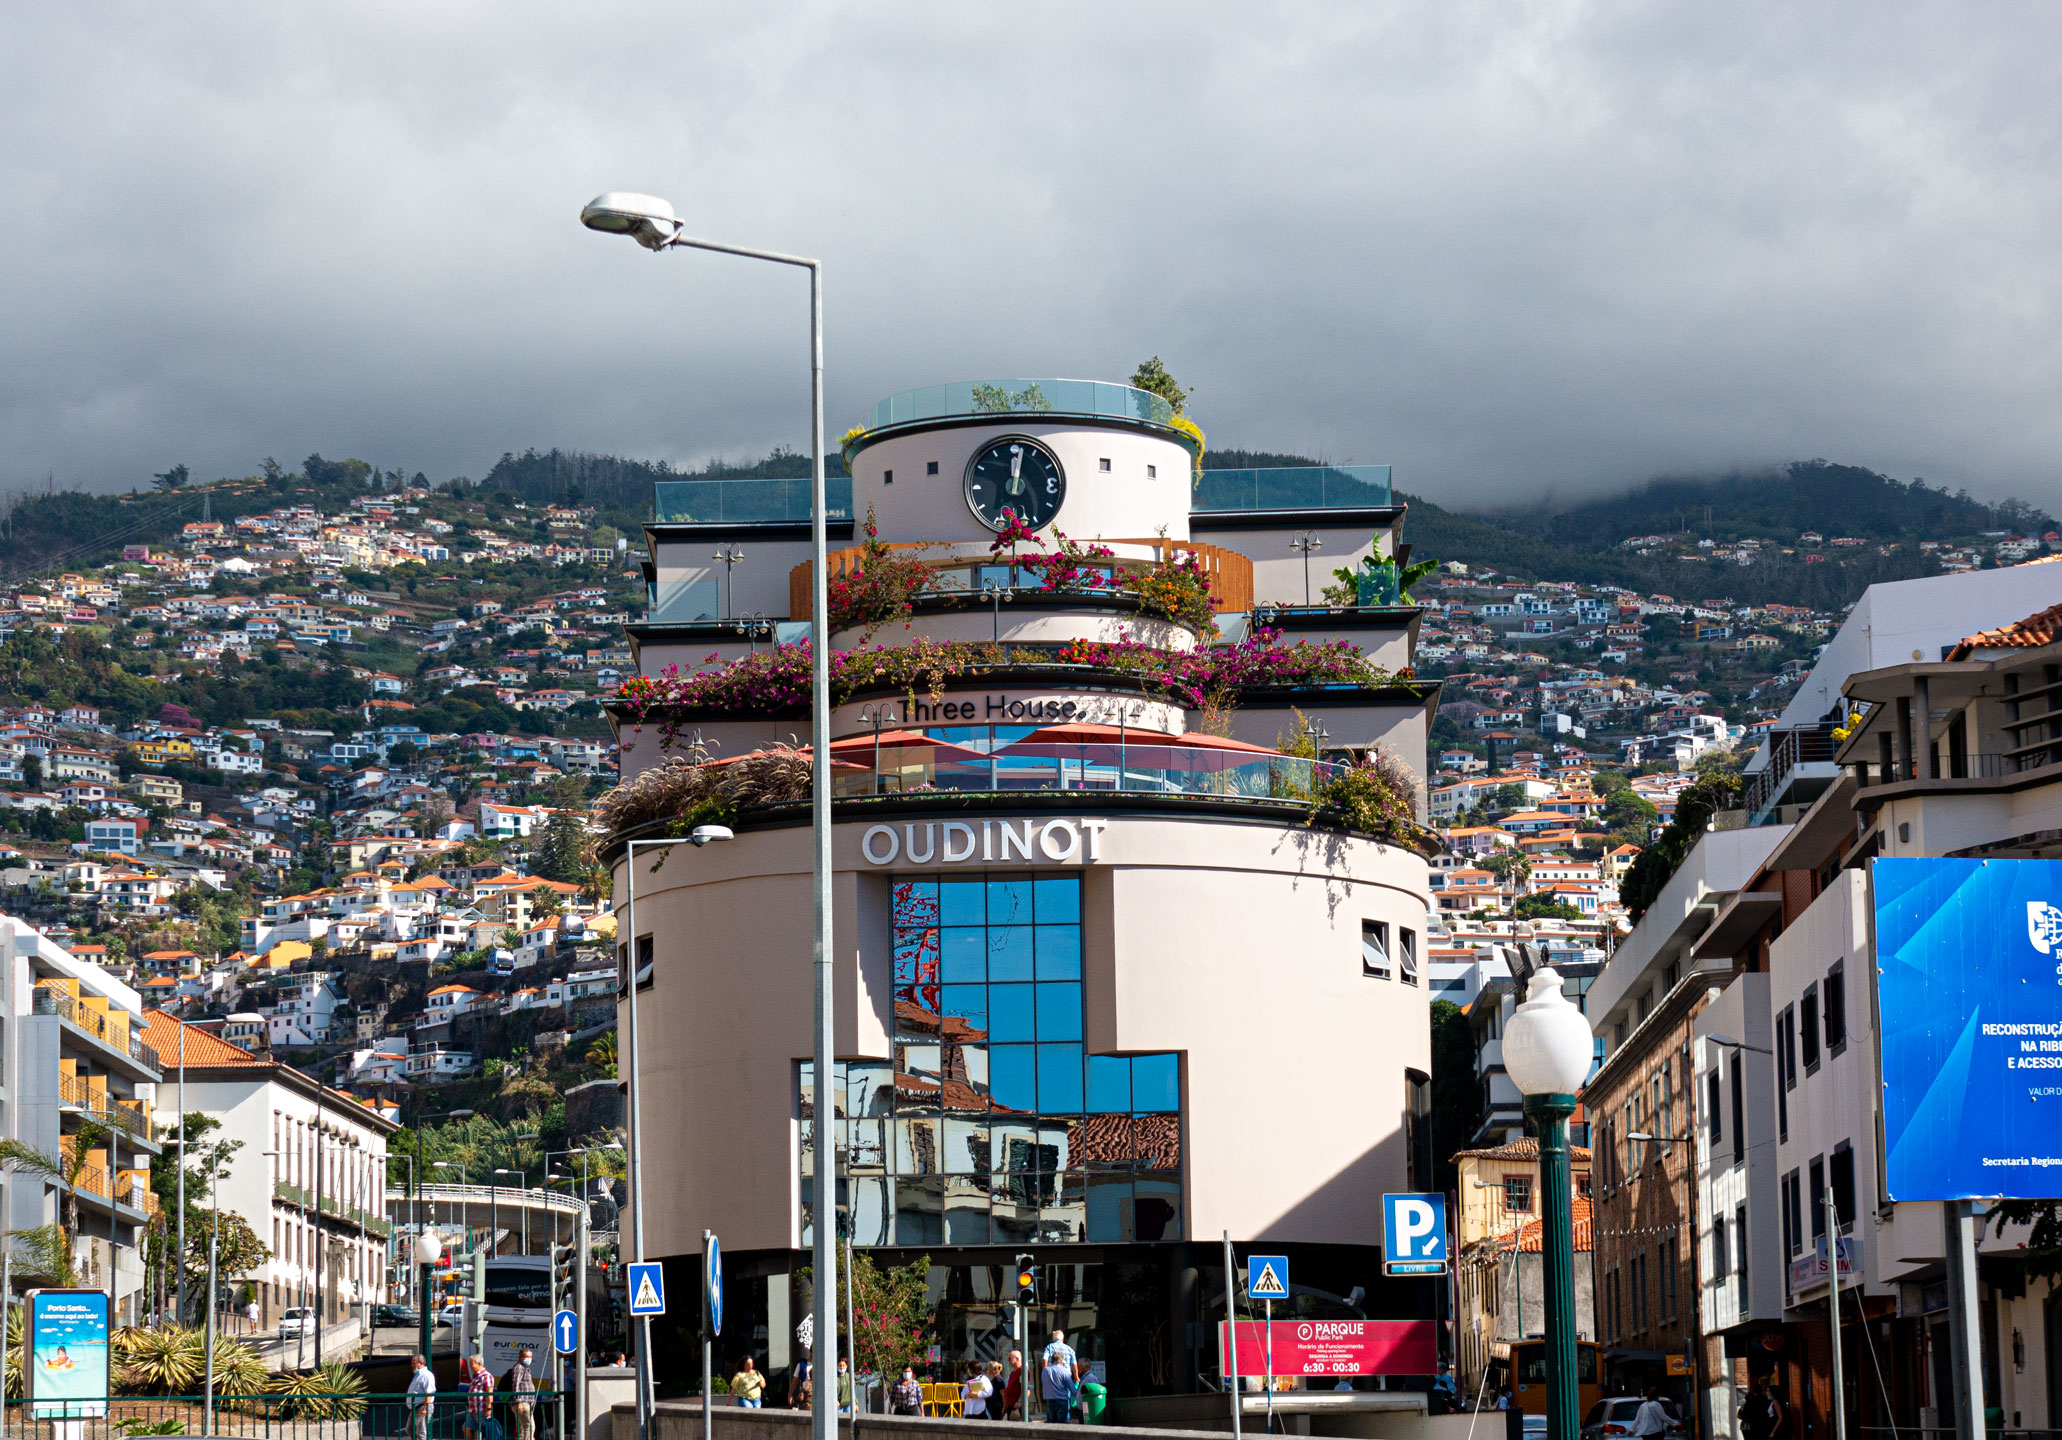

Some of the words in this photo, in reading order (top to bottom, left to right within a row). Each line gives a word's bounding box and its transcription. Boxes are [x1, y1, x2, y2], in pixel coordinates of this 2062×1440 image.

[897, 698, 976, 723] Three
[862, 818, 1107, 865] OUDINOT
[2020, 1040, 2038, 1052] NA
[2007, 1057, 2016, 1069] E
[2018, 1057, 2062, 1069] ACESSO
[2028, 1087, 2055, 1096] VALOR
[1982, 1156, 2029, 1167] Secretaria
[1395, 1200, 1435, 1256] P
[1403, 1264, 1427, 1273] LIVRE
[47, 1304, 67, 1312] Porto
[1315, 1323, 1364, 1335] PARQUE
[1303, 1362, 1324, 1372] 6:30
[1332, 1362, 1360, 1372] 00:30
